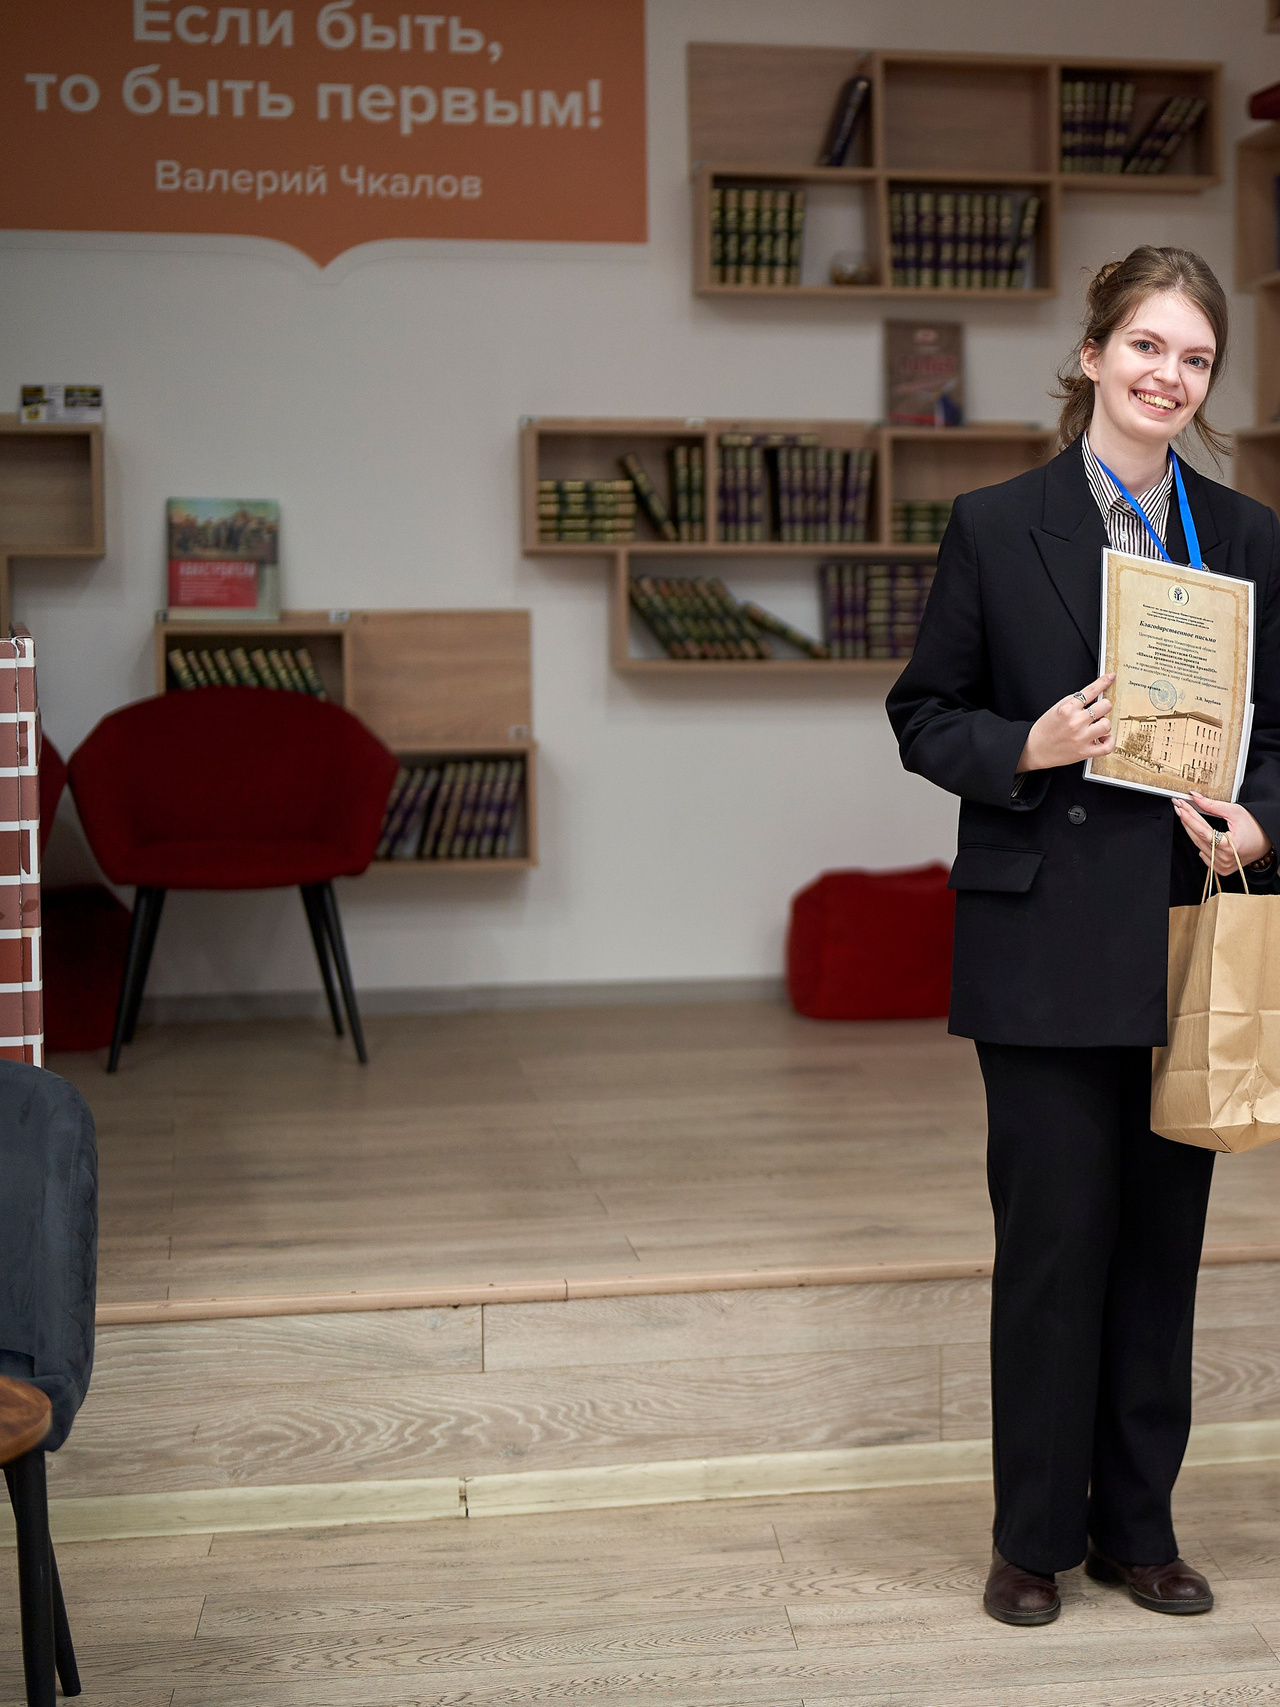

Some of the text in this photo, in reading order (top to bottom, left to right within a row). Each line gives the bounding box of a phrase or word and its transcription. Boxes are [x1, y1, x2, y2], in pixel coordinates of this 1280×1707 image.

[134, 0, 504, 63] Если быть,
[25, 64, 604, 136] то быть первым!
[155, 159, 484, 201] Валерий Чкалов
[1139, 620, 1216, 643] Благодарственное письмо
